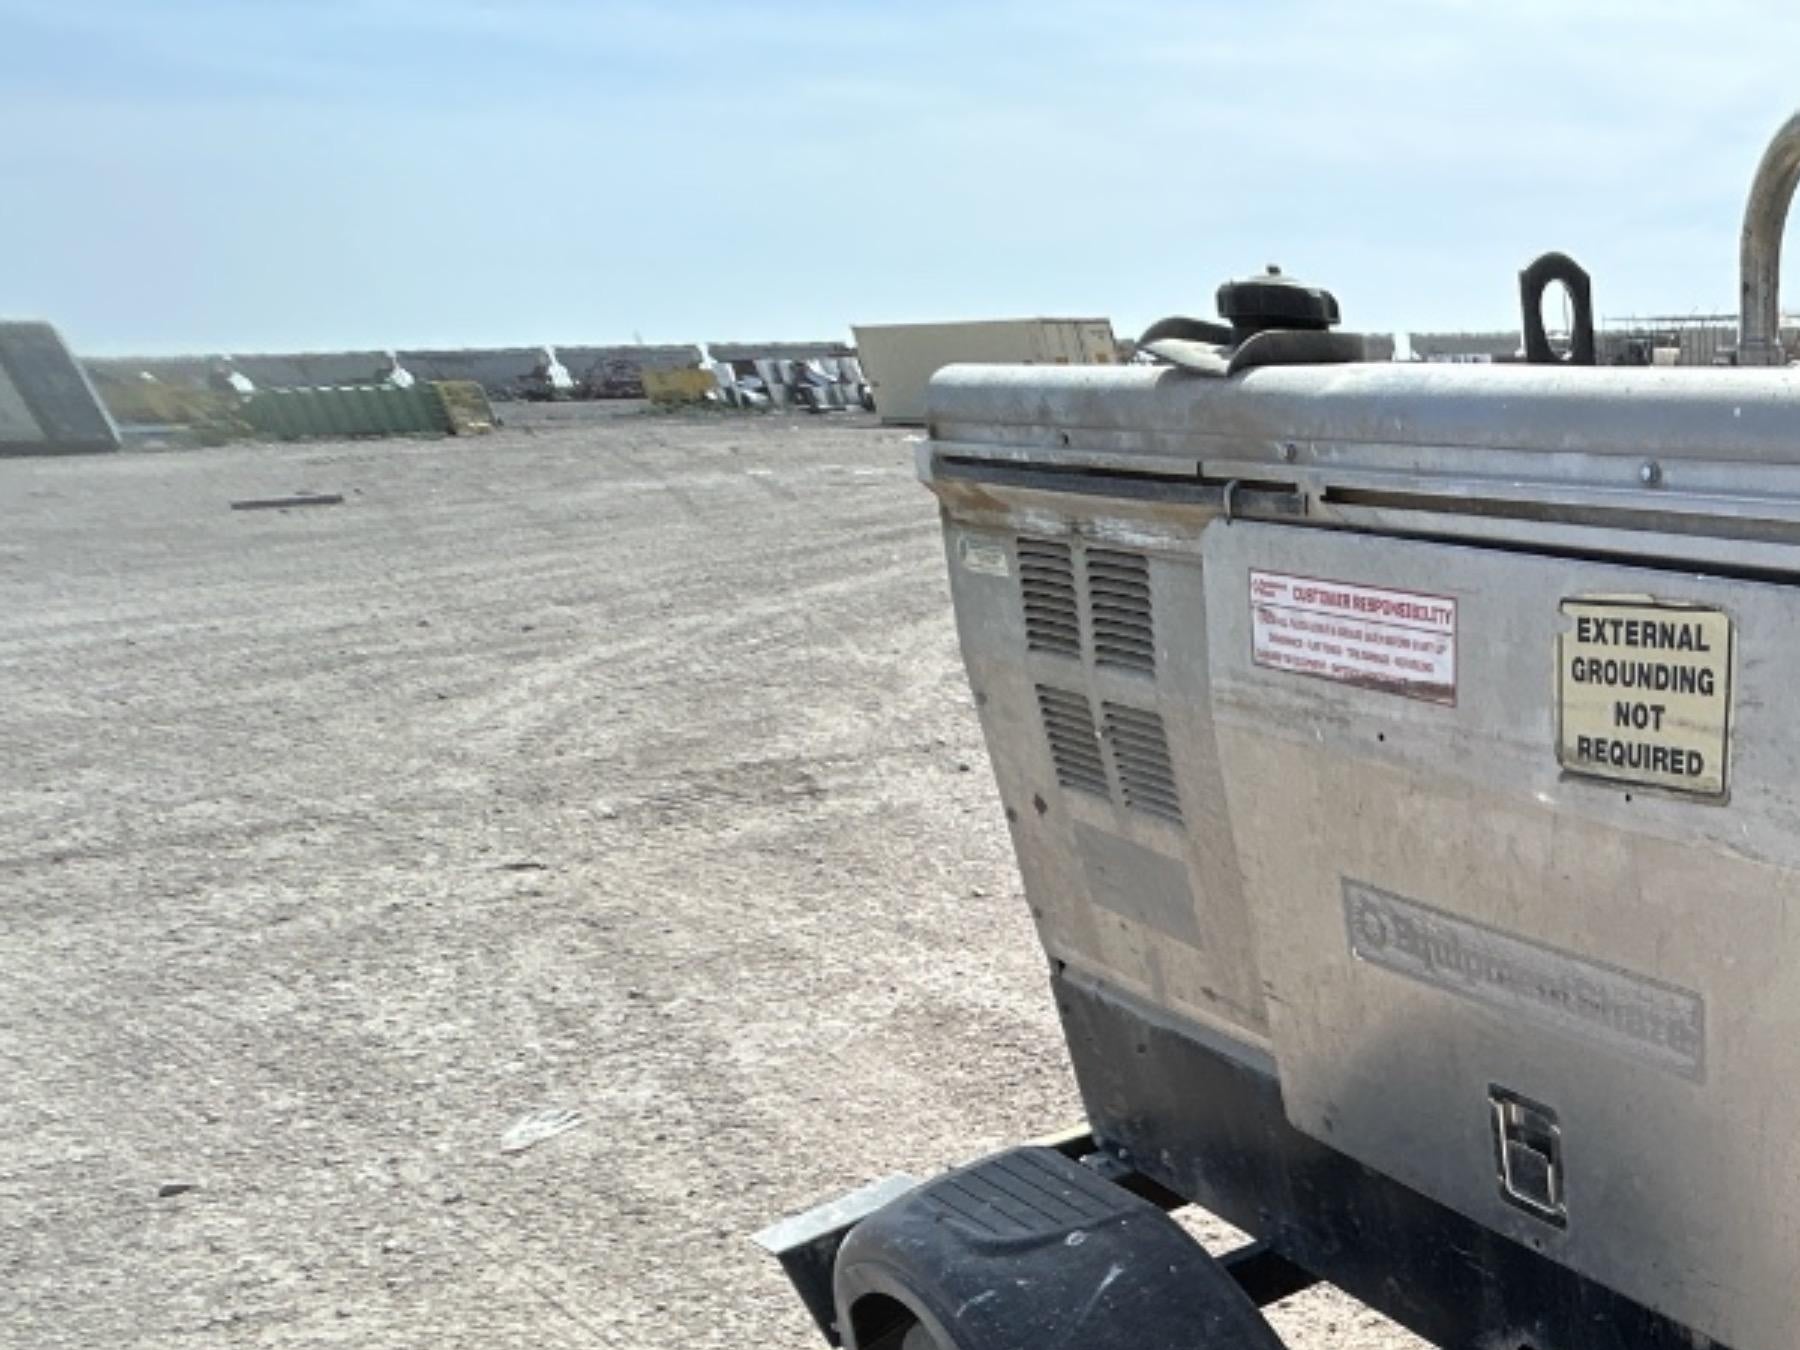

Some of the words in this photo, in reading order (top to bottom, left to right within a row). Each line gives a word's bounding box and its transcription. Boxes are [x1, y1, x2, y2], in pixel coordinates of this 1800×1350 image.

[1577, 616, 1711, 652] EXTERNAL
[1571, 656, 1714, 696] GROUNDING
[1615, 701, 1665, 732] NOT
[1577, 735, 1704, 777] REQUIRED
